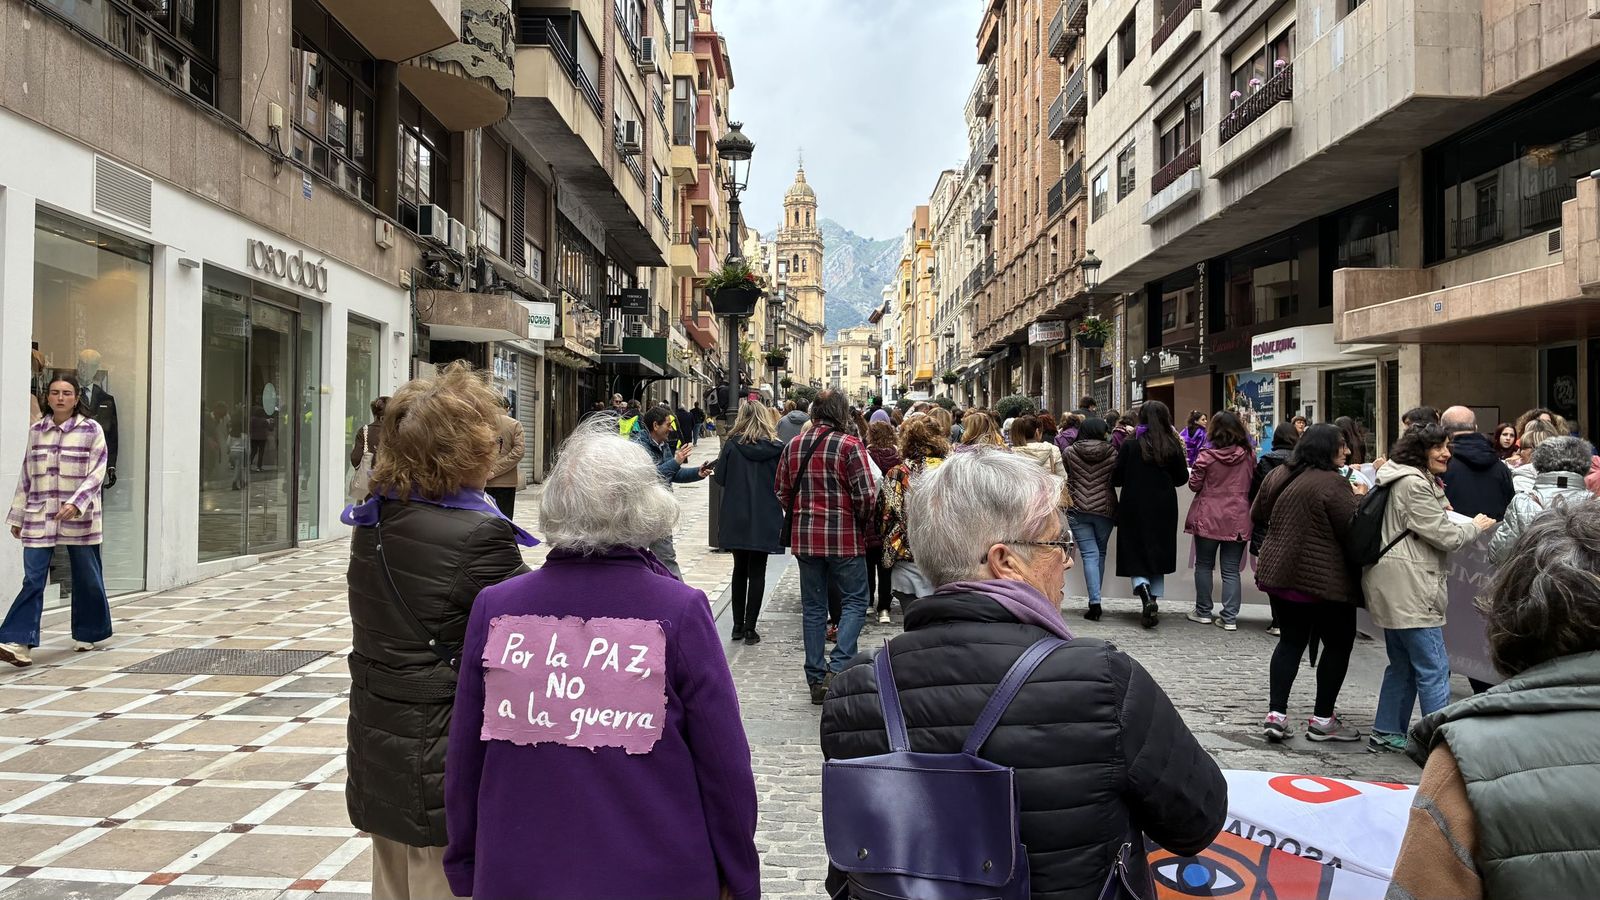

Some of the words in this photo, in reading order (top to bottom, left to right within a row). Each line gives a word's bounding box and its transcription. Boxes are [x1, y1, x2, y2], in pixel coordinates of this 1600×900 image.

[1197, 262, 1205, 364] Restaurante
[501, 633, 535, 668] Por
[546, 632, 569, 668] la
[583, 637, 651, 679] PAZ,
[546, 672, 586, 699] NO
[497, 699, 516, 719] a
[527, 691, 558, 728] la
[564, 707, 657, 740] guerra
